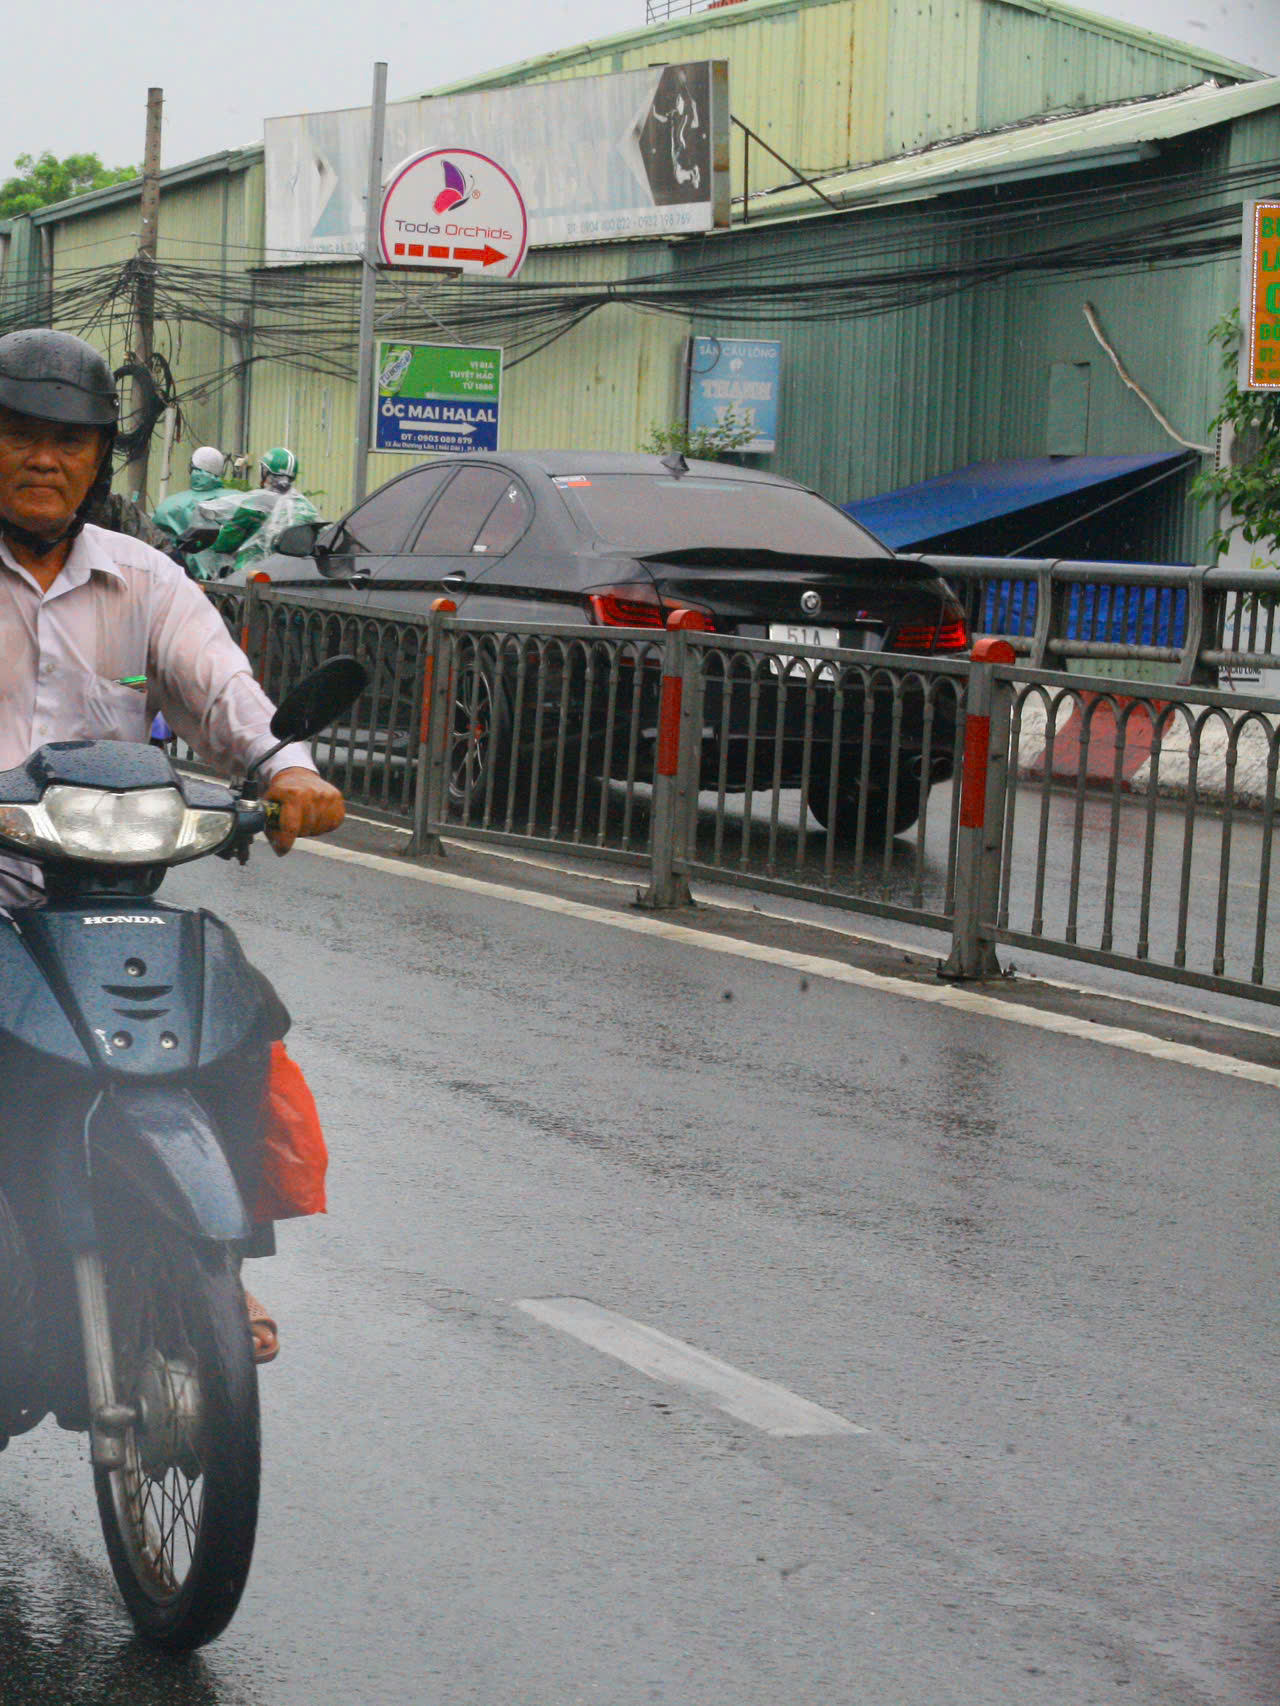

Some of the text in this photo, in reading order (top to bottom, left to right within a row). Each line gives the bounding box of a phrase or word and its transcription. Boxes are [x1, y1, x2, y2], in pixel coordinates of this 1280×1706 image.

[395, 220, 513, 240] Toda Orchids
[380, 357, 408, 385] TUBORG
[382, 398, 496, 423] ỐC MAI HALAL
[417, 434, 439, 444] 0903
[440, 435, 456, 445] 089
[82, 915, 166, 925] HONDA
